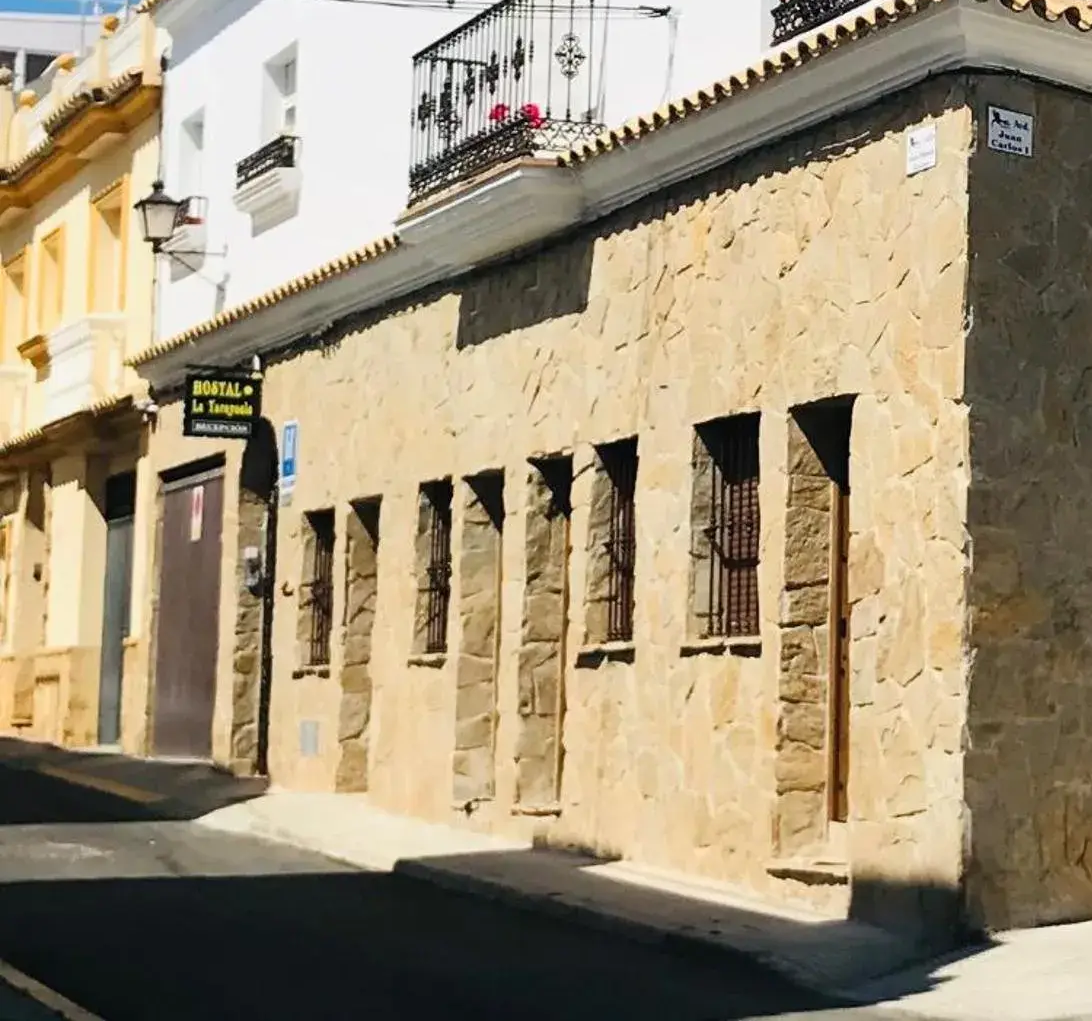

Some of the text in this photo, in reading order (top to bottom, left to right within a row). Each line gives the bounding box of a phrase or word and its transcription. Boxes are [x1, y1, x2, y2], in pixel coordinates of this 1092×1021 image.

[998, 130, 1023, 142] Juan
[991, 139, 1023, 152] Carlos
[192, 380, 242, 398] HOSTAL
[191, 398, 204, 414] La
